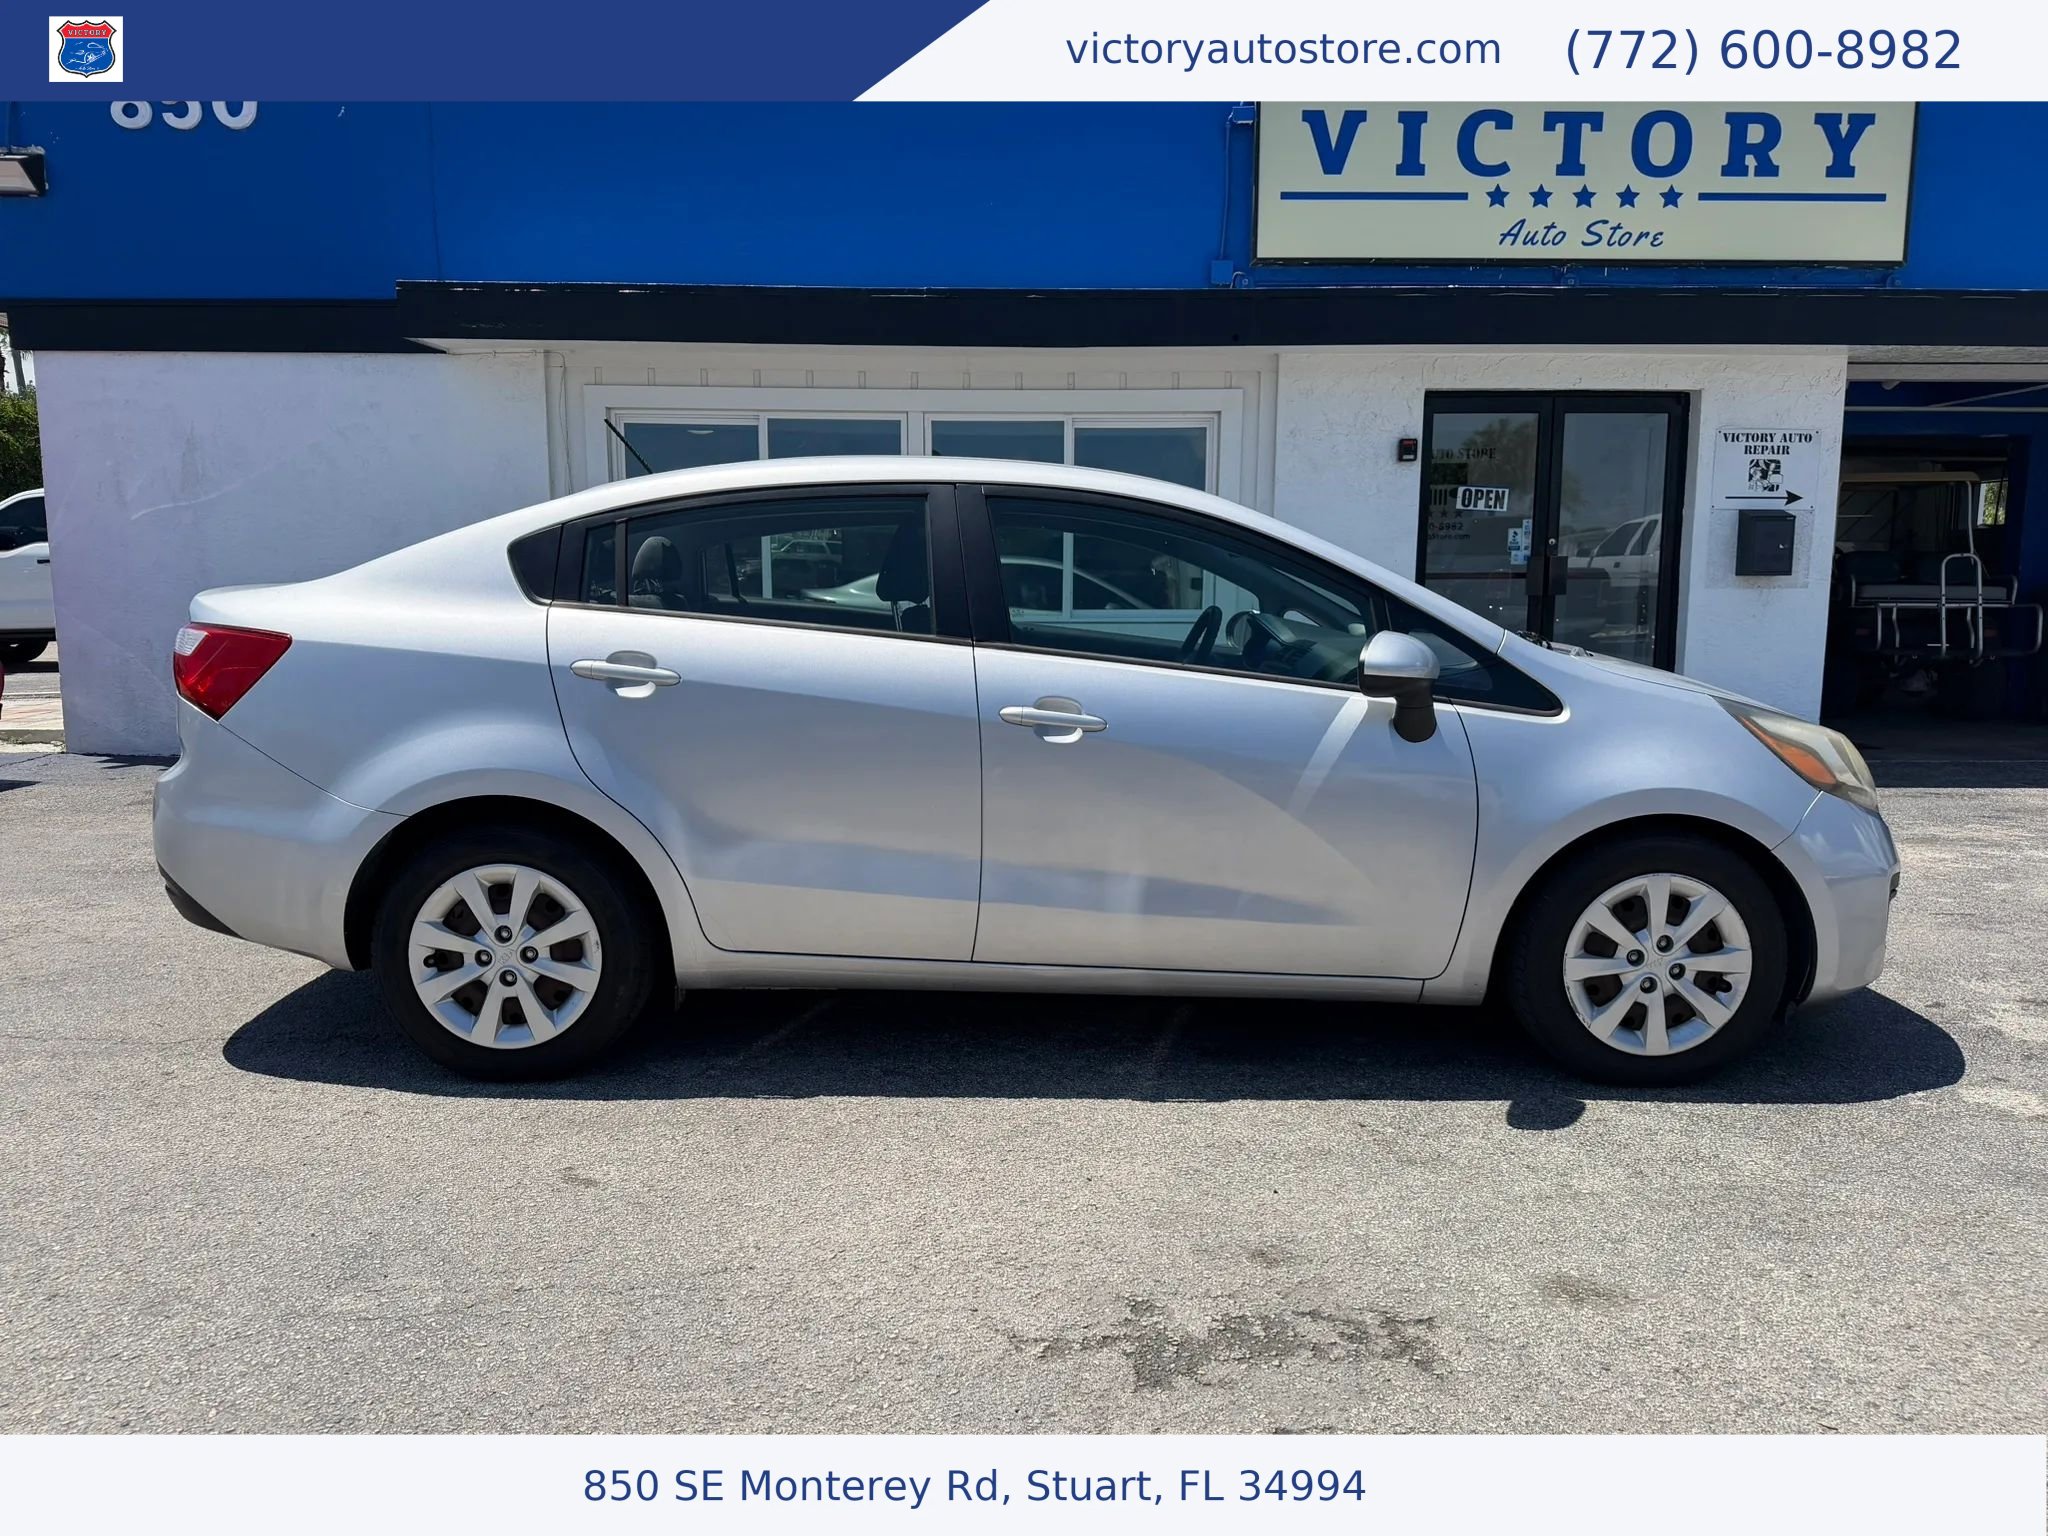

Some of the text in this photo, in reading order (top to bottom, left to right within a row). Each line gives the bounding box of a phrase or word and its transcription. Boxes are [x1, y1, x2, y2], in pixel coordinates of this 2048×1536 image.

[1301, 109, 1877, 179] VICTORY
[1498, 217, 1664, 248] Auto Store
[1723, 432, 1812, 443] VICTORY AUTO
[1743, 445, 1790, 455] REPAIR
[1461, 487, 1506, 510] OPEN
